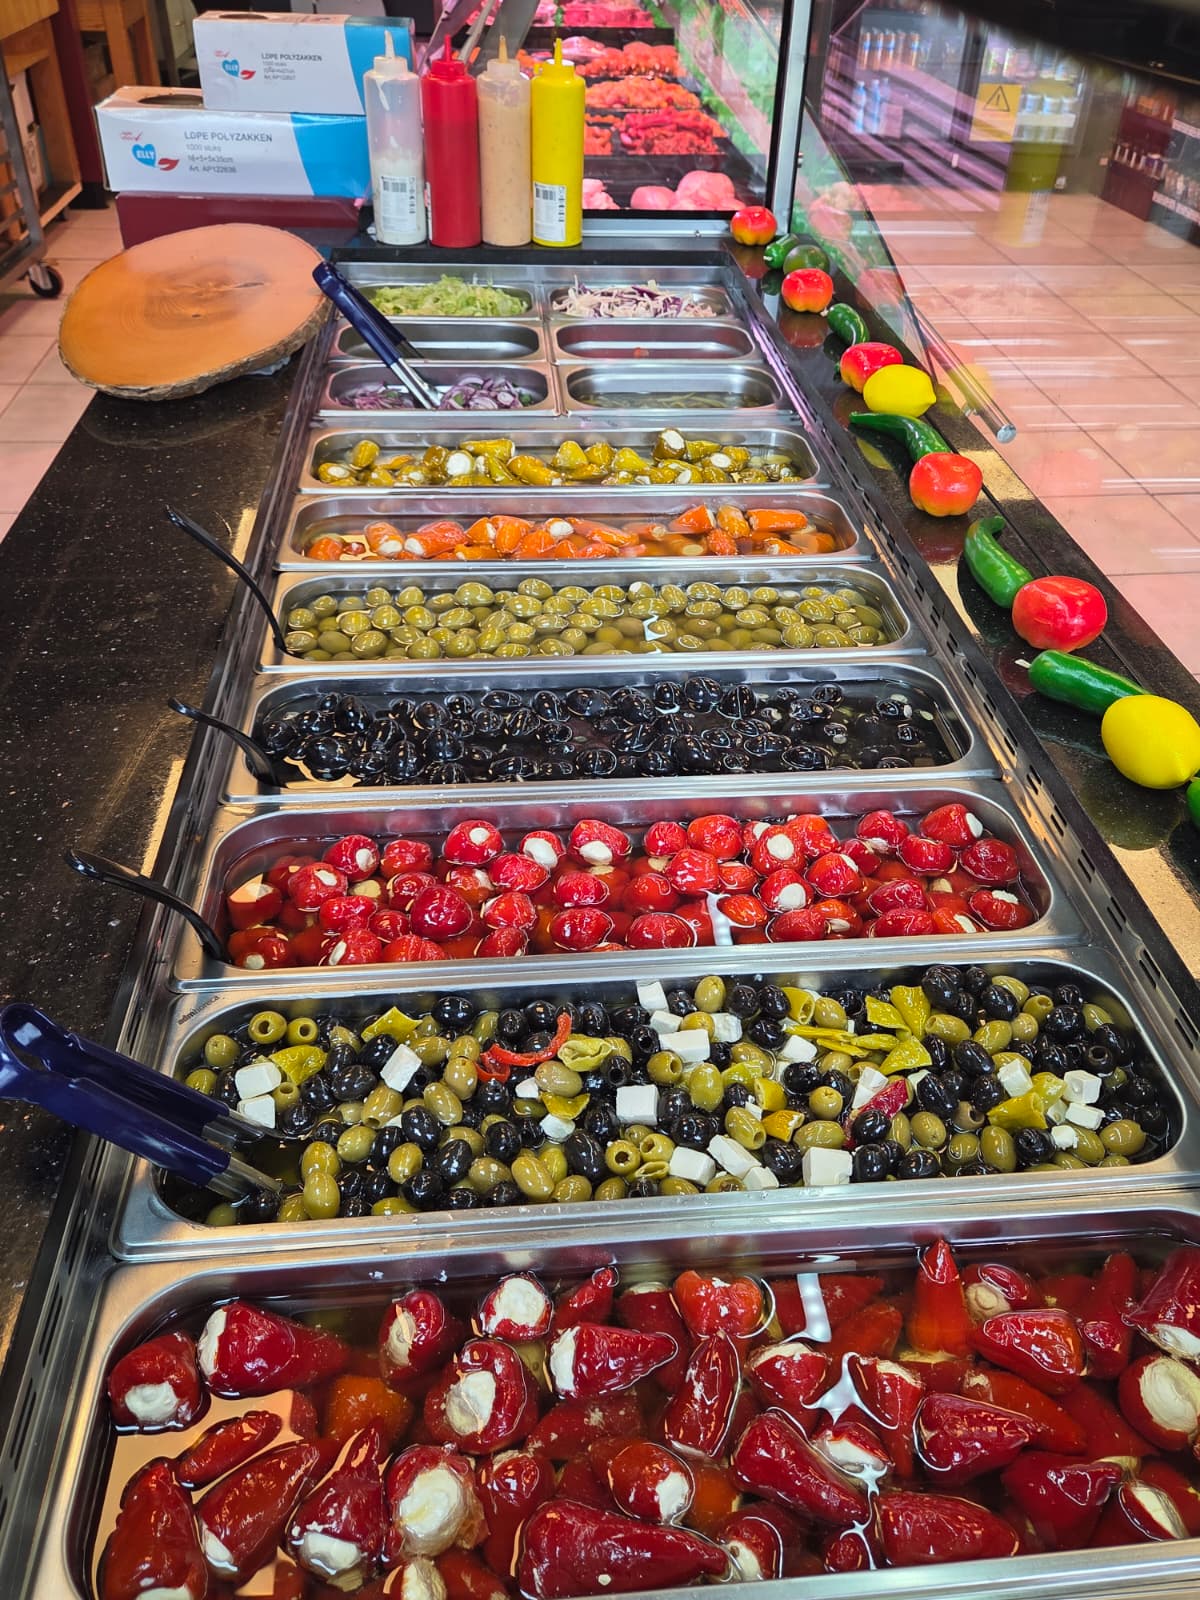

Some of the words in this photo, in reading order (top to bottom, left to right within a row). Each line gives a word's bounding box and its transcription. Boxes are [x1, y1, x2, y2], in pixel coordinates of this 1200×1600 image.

[184, 131, 209, 140] LDPE
[210, 131, 273, 143] POLYZAKKEN
[135, 150, 155, 160] ELLY
